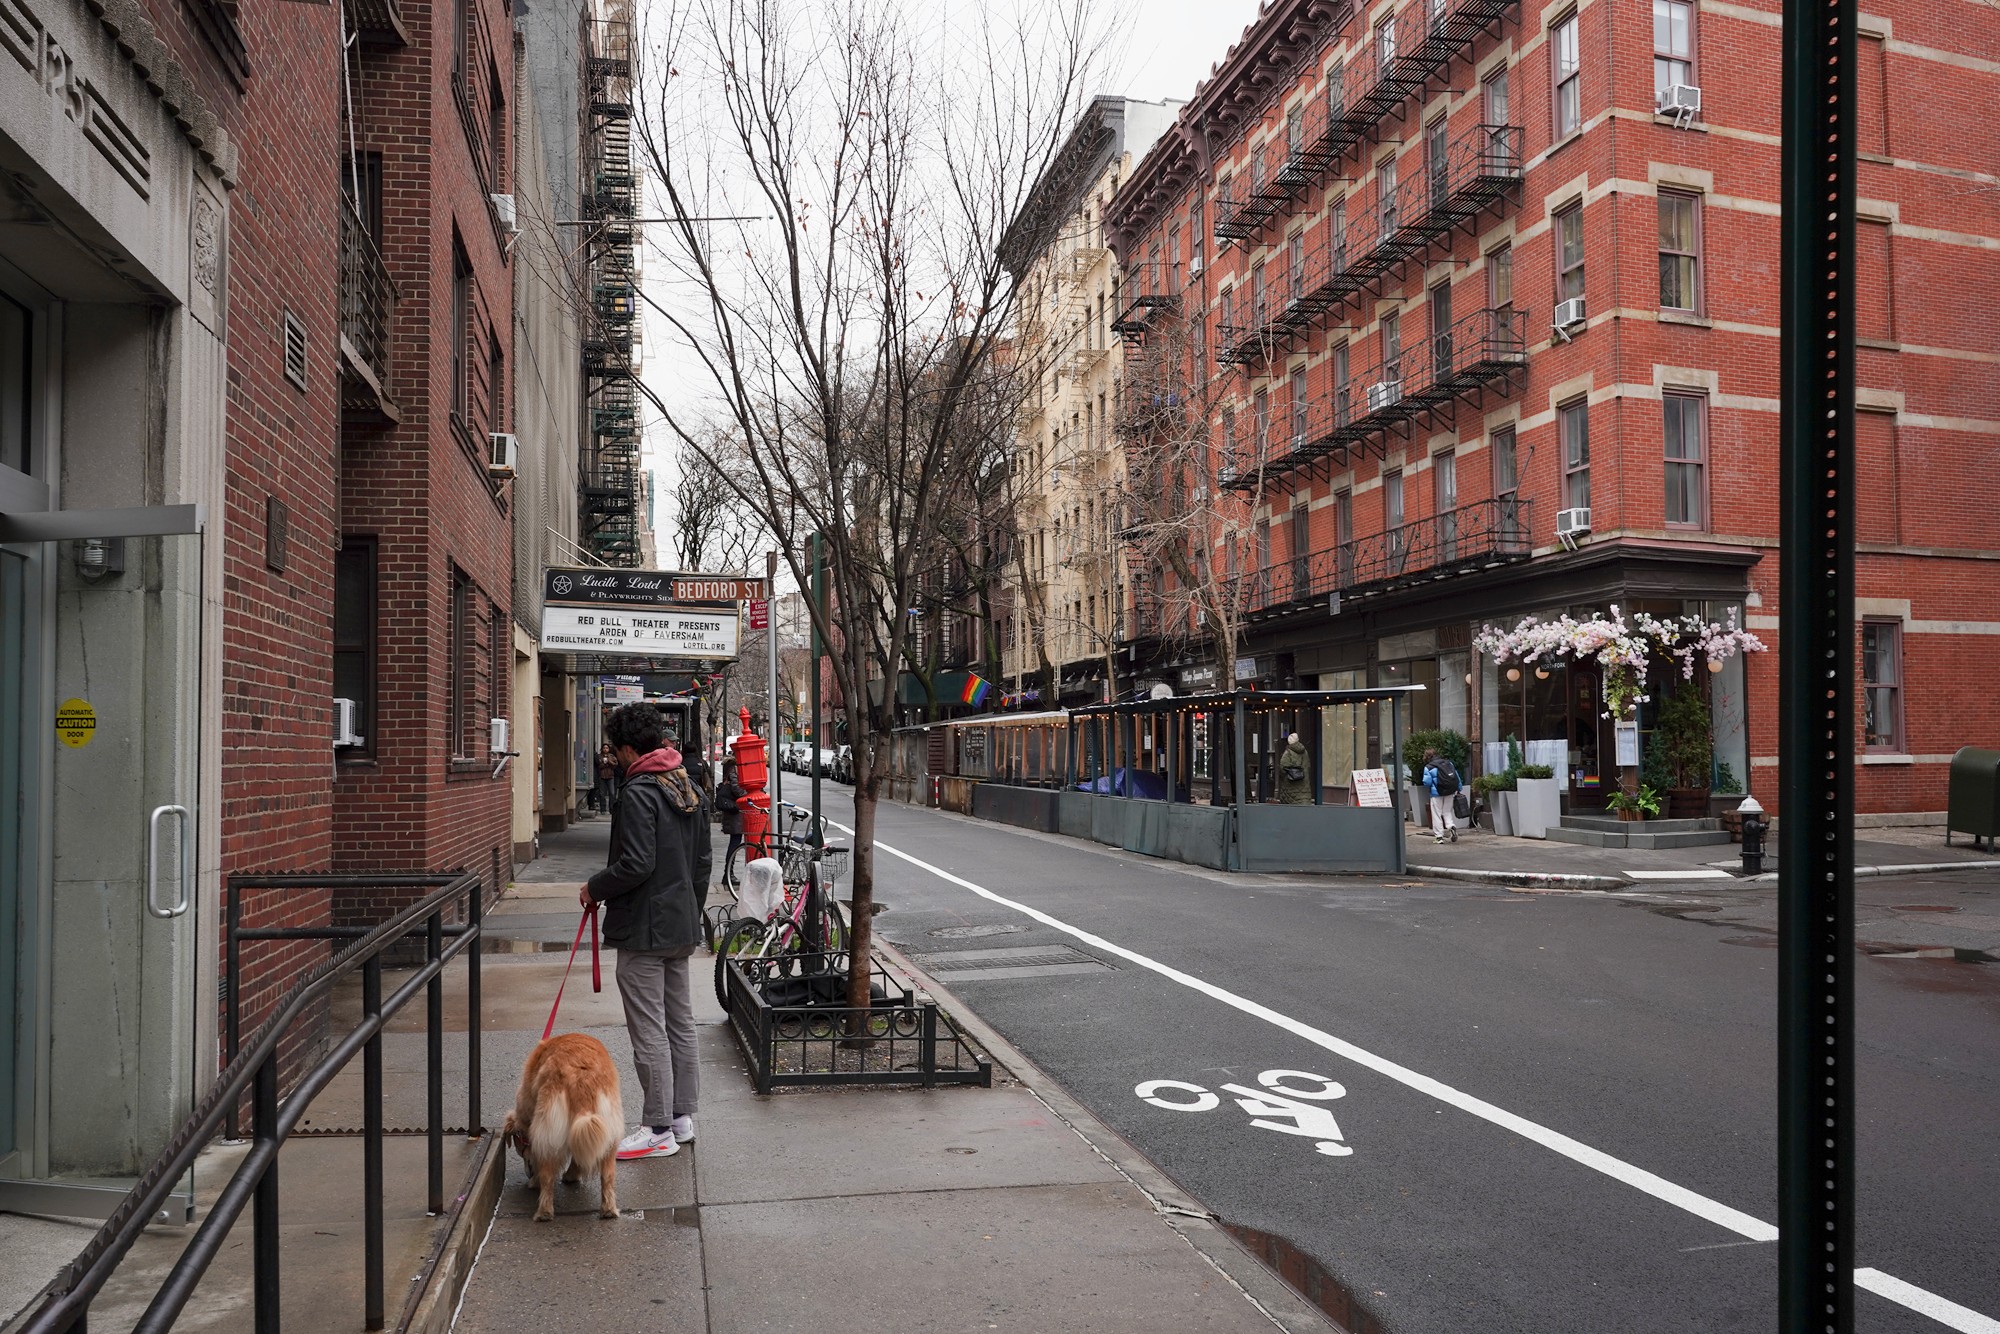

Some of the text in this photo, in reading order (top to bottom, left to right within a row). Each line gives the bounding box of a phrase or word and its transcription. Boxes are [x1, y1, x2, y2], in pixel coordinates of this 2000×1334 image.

[580, 574, 619, 588] Lucille
[626, 576, 662, 590] Lortel
[678, 581, 737, 599] BEDFORD
[744, 581, 759, 599] ST
[578, 616, 720, 631] RED BULL THEATER PRESENTS
[546, 635, 624, 645] REDBULLTHEATER.COM
[600, 628, 705, 640] ARDEN OF FAVERSHAM
[683, 642, 725, 651] LORTEL.ORG
[58, 719, 94, 727] CAUTION
